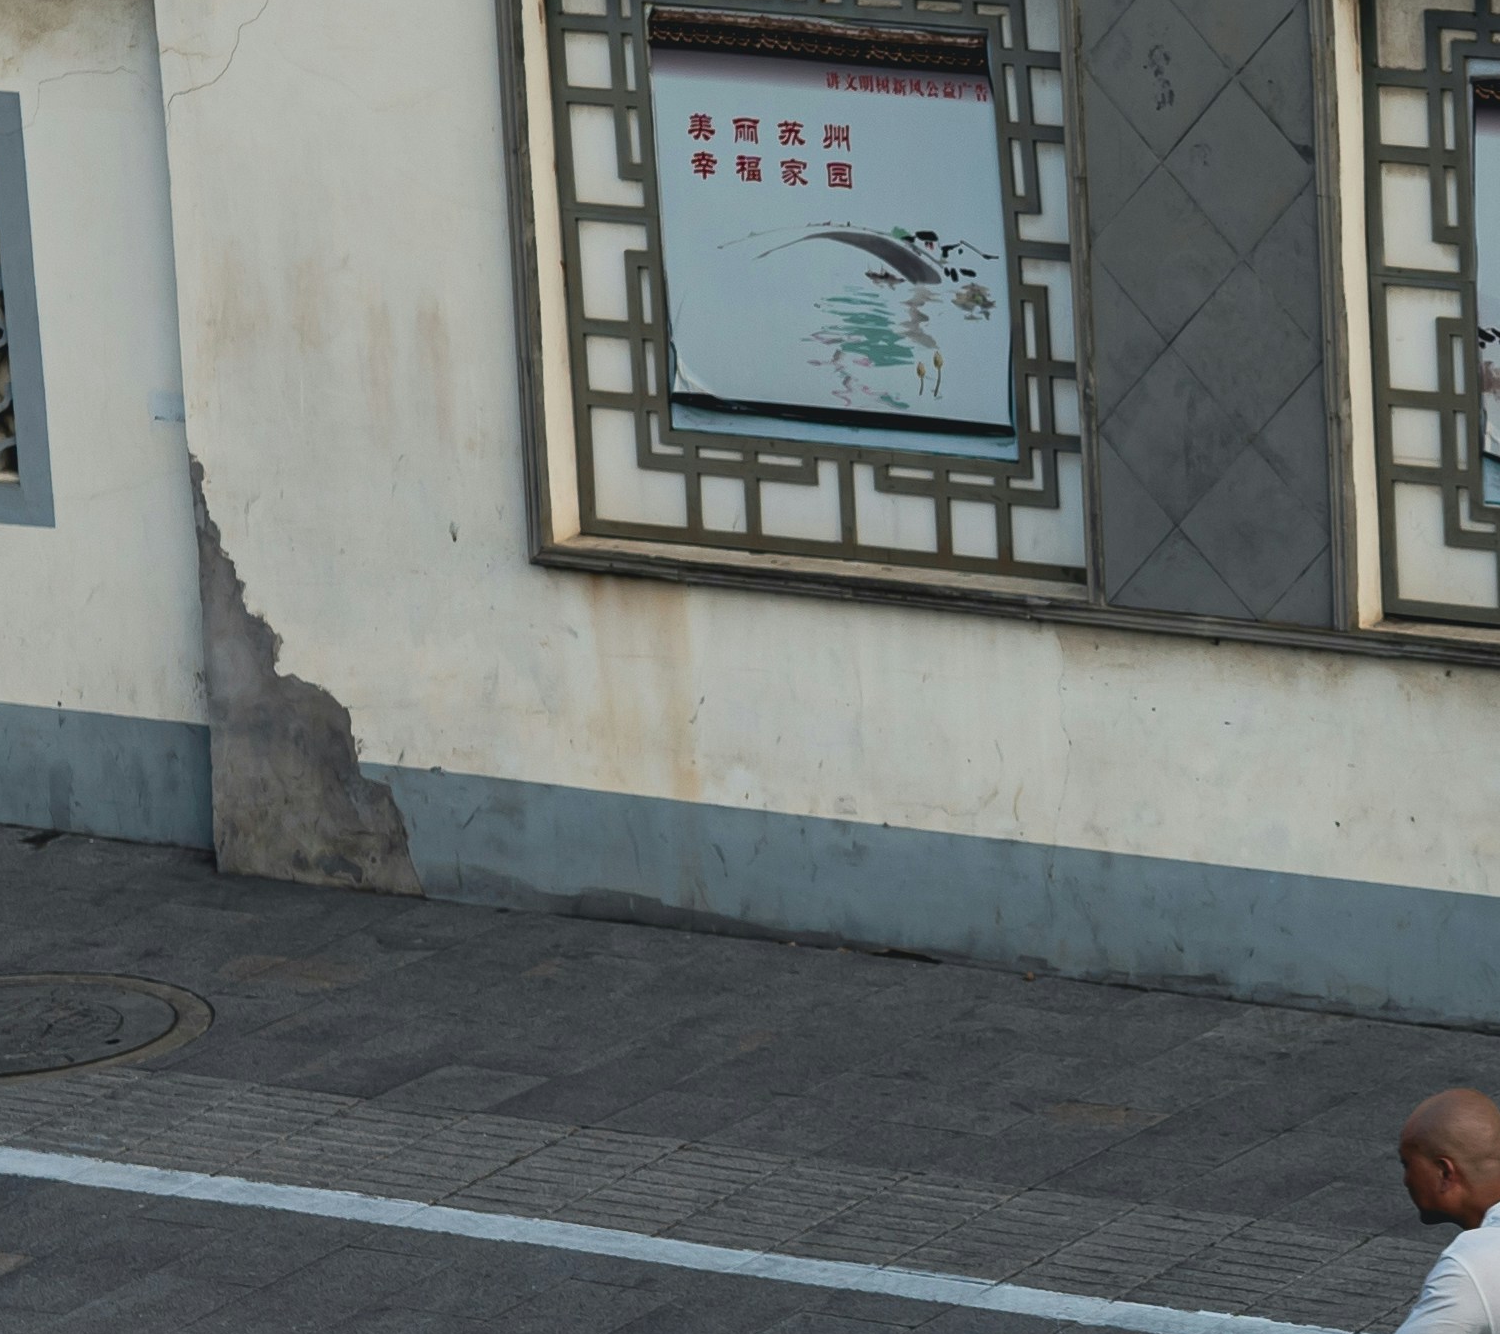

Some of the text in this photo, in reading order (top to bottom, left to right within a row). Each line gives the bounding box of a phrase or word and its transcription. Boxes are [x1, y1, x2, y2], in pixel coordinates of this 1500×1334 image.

[826, 71, 989, 102] 讲文明树新风公益广告
[687, 113, 851, 152] 美丽苏州
[690, 151, 853, 189] 幸福家园
